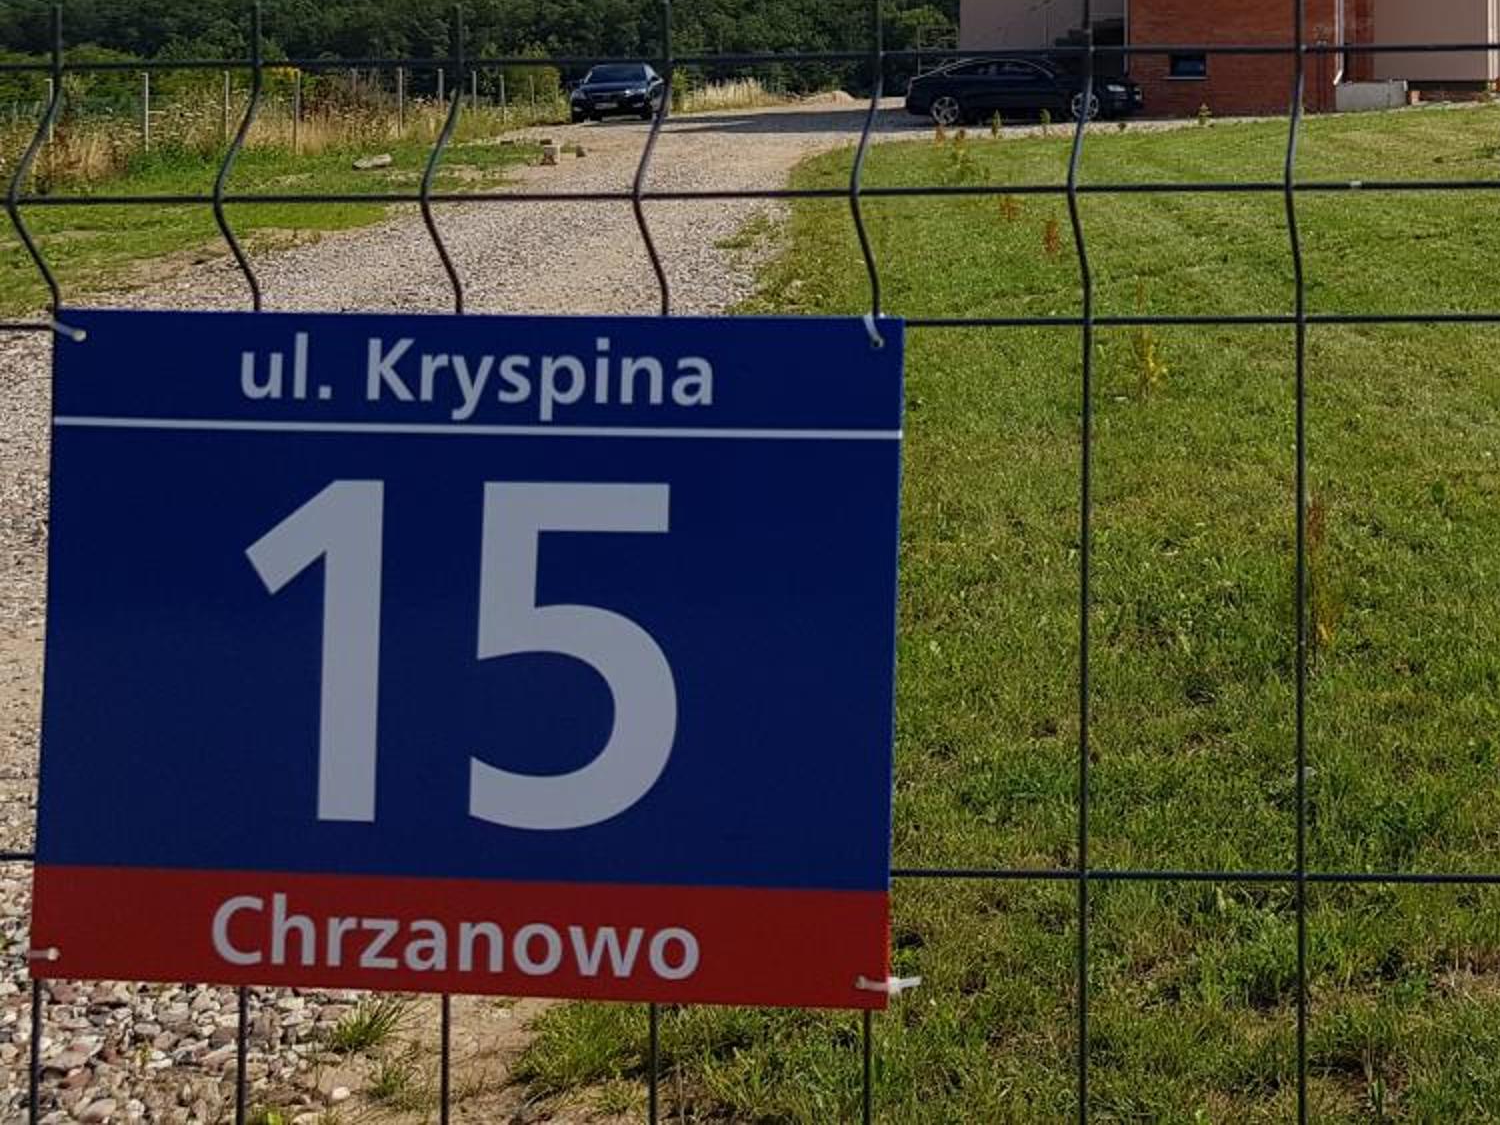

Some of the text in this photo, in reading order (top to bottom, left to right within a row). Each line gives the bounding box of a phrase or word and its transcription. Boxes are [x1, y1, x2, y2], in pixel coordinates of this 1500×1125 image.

[241, 332, 716, 421] ul. Kryspina
[245, 479, 678, 830] 15
[211, 893, 701, 980] Chrzanowo
